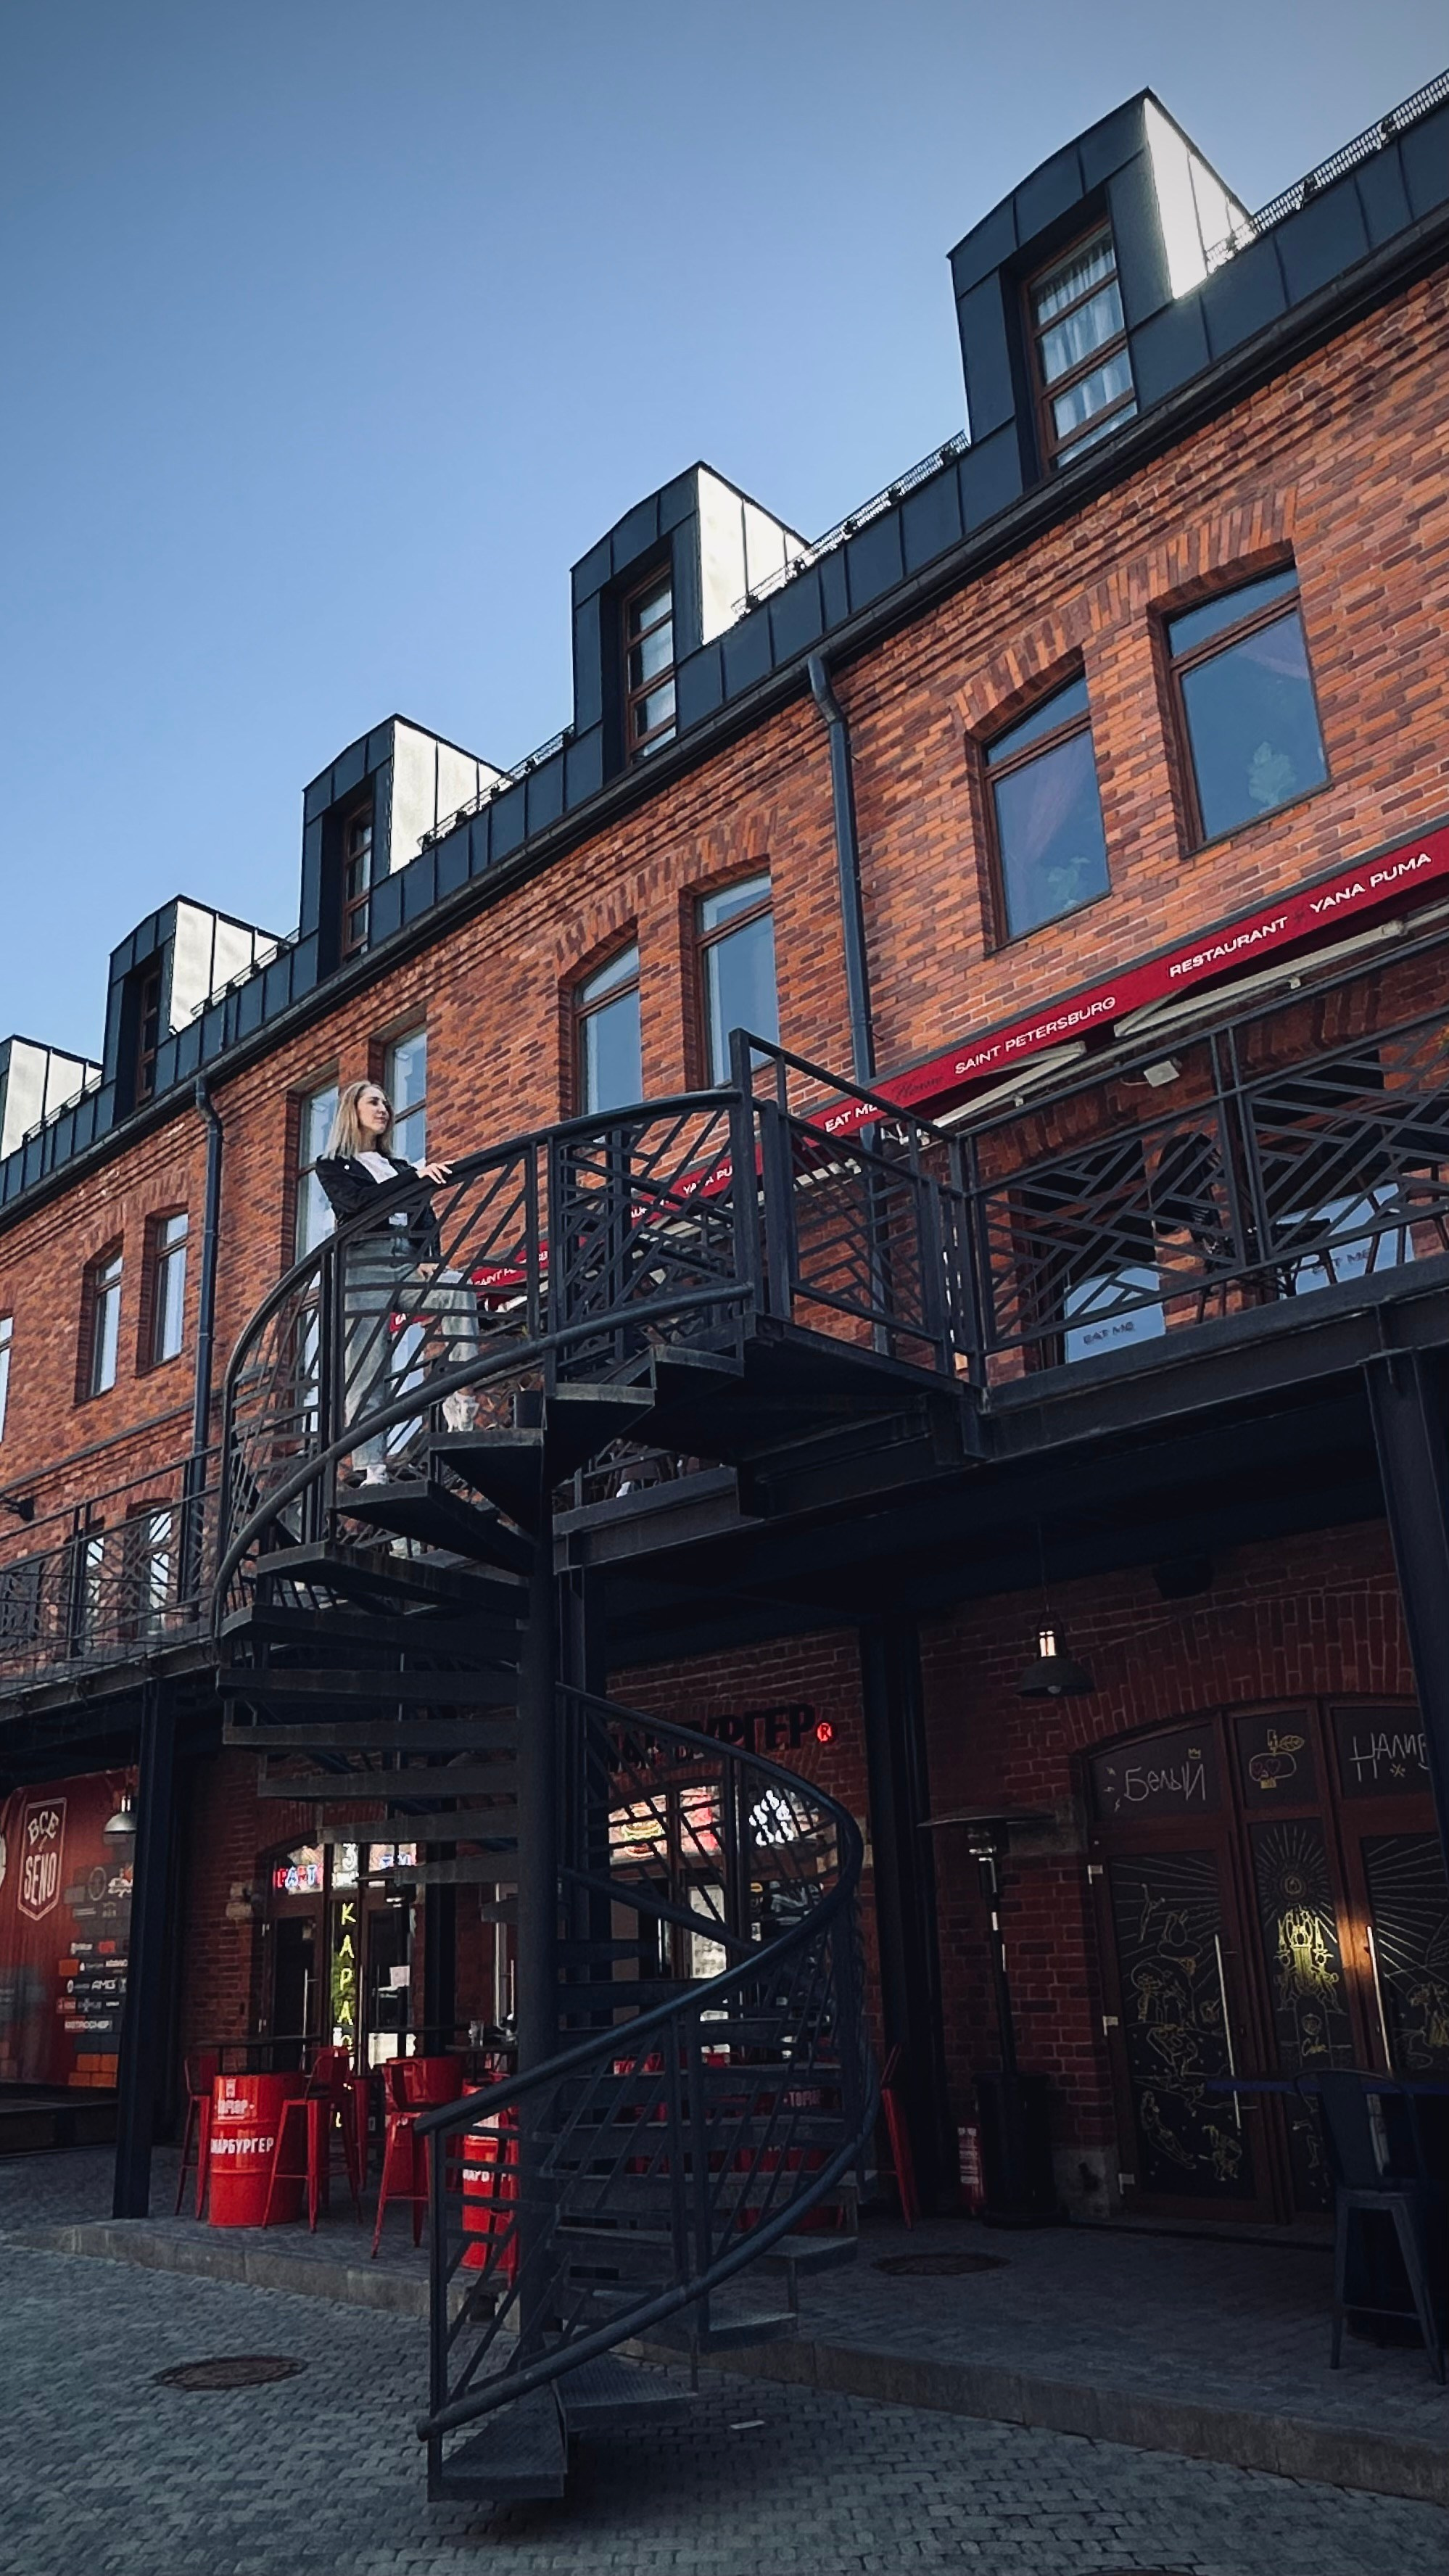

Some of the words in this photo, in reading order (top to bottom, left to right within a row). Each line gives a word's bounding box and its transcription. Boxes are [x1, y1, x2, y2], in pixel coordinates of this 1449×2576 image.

[1310, 882, 1366, 914] YANA
[1370, 852, 1432, 888] PUMA
[1169, 916, 1288, 978] RESTAURANT
[954, 1045, 1002, 1074] SAINT
[1005, 996, 1116, 1052] PETERSBURG
[824, 1110, 851, 1133] EAT
[1083, 1329, 1109, 1345] EAT
[1112, 1321, 1135, 1335] ME
[23, 1852, 57, 1906] SENO
